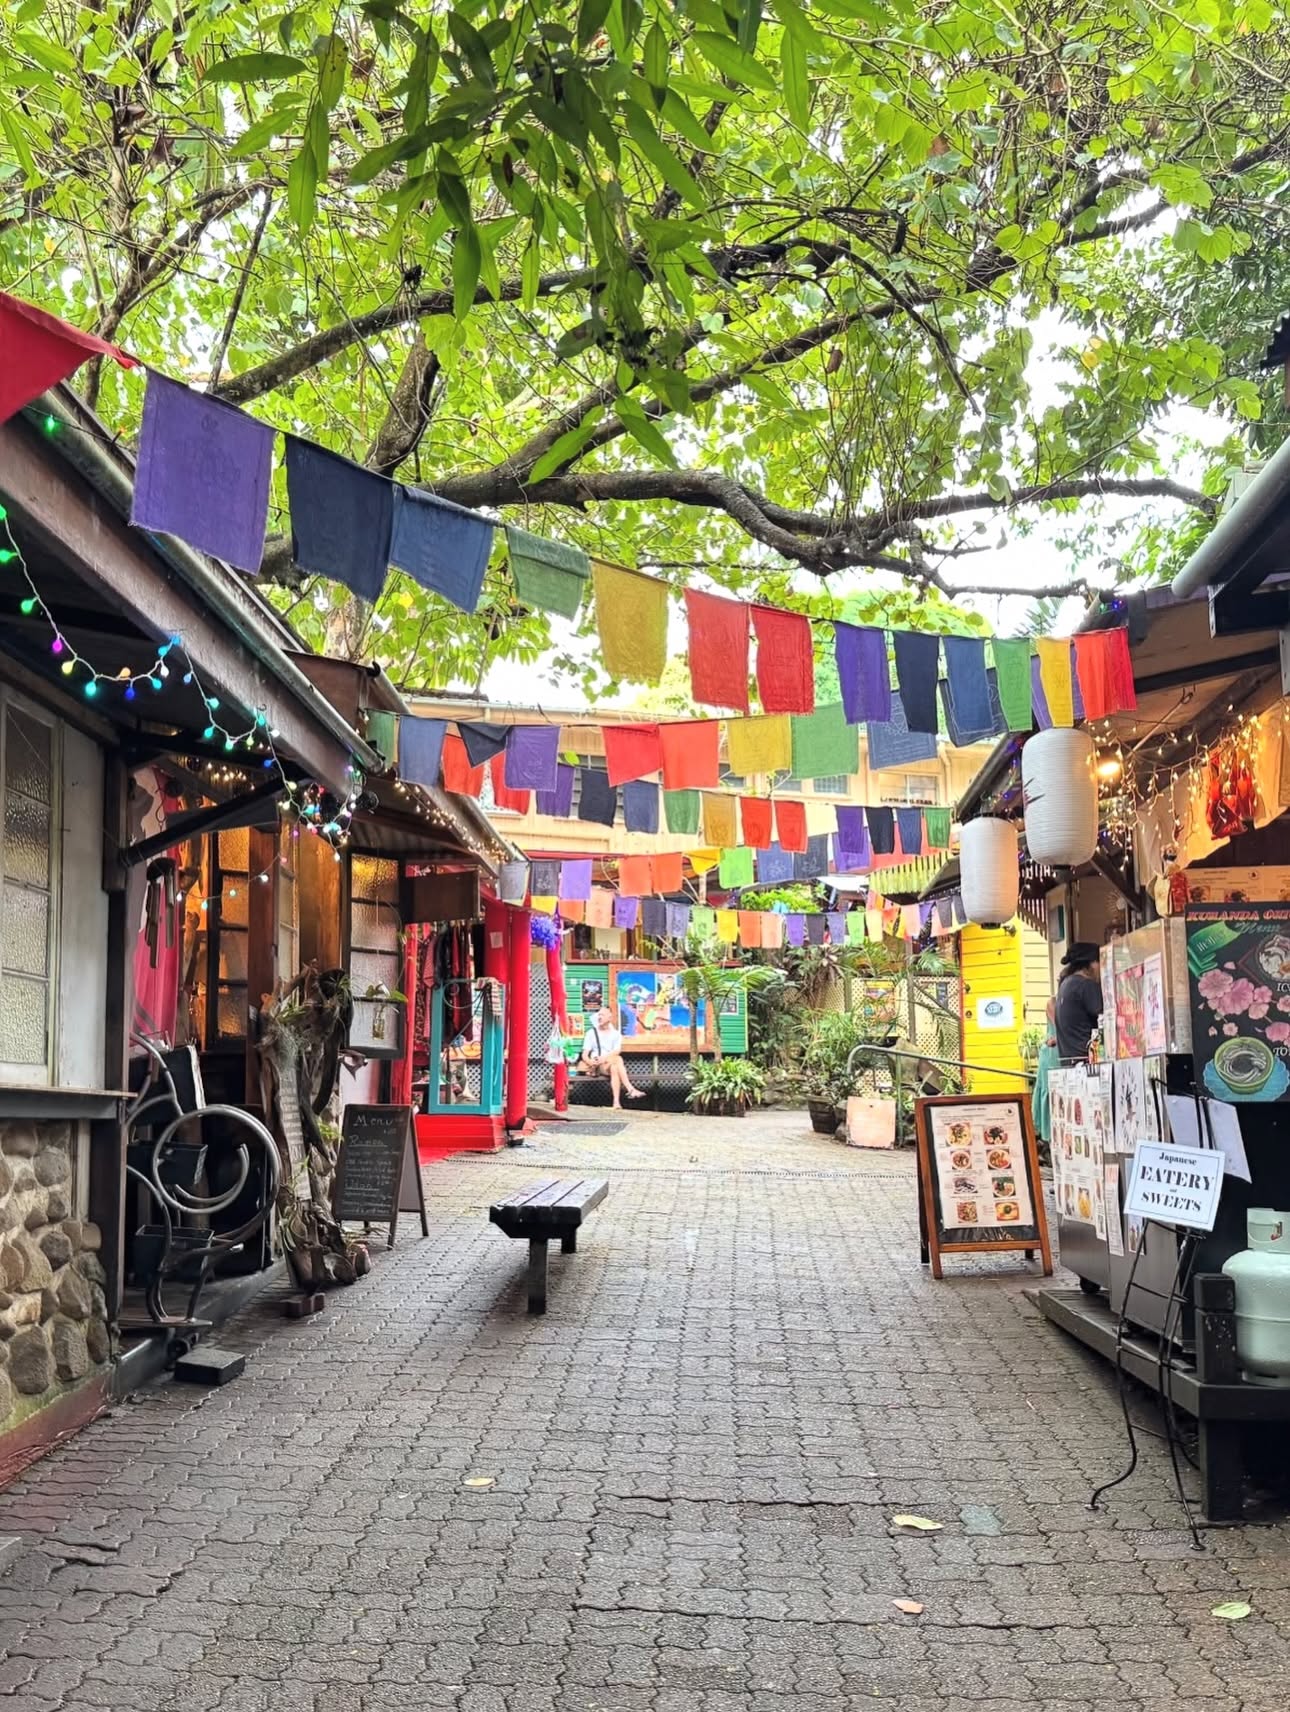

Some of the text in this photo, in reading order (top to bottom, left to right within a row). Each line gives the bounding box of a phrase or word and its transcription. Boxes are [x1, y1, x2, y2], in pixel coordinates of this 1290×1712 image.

[353, 1114, 394, 1127] Menu
[1159, 1152, 1198, 1166] Japanese
[1140, 1165, 1214, 1191] EATERY
[1141, 1191, 1202, 1212] SWEETS
